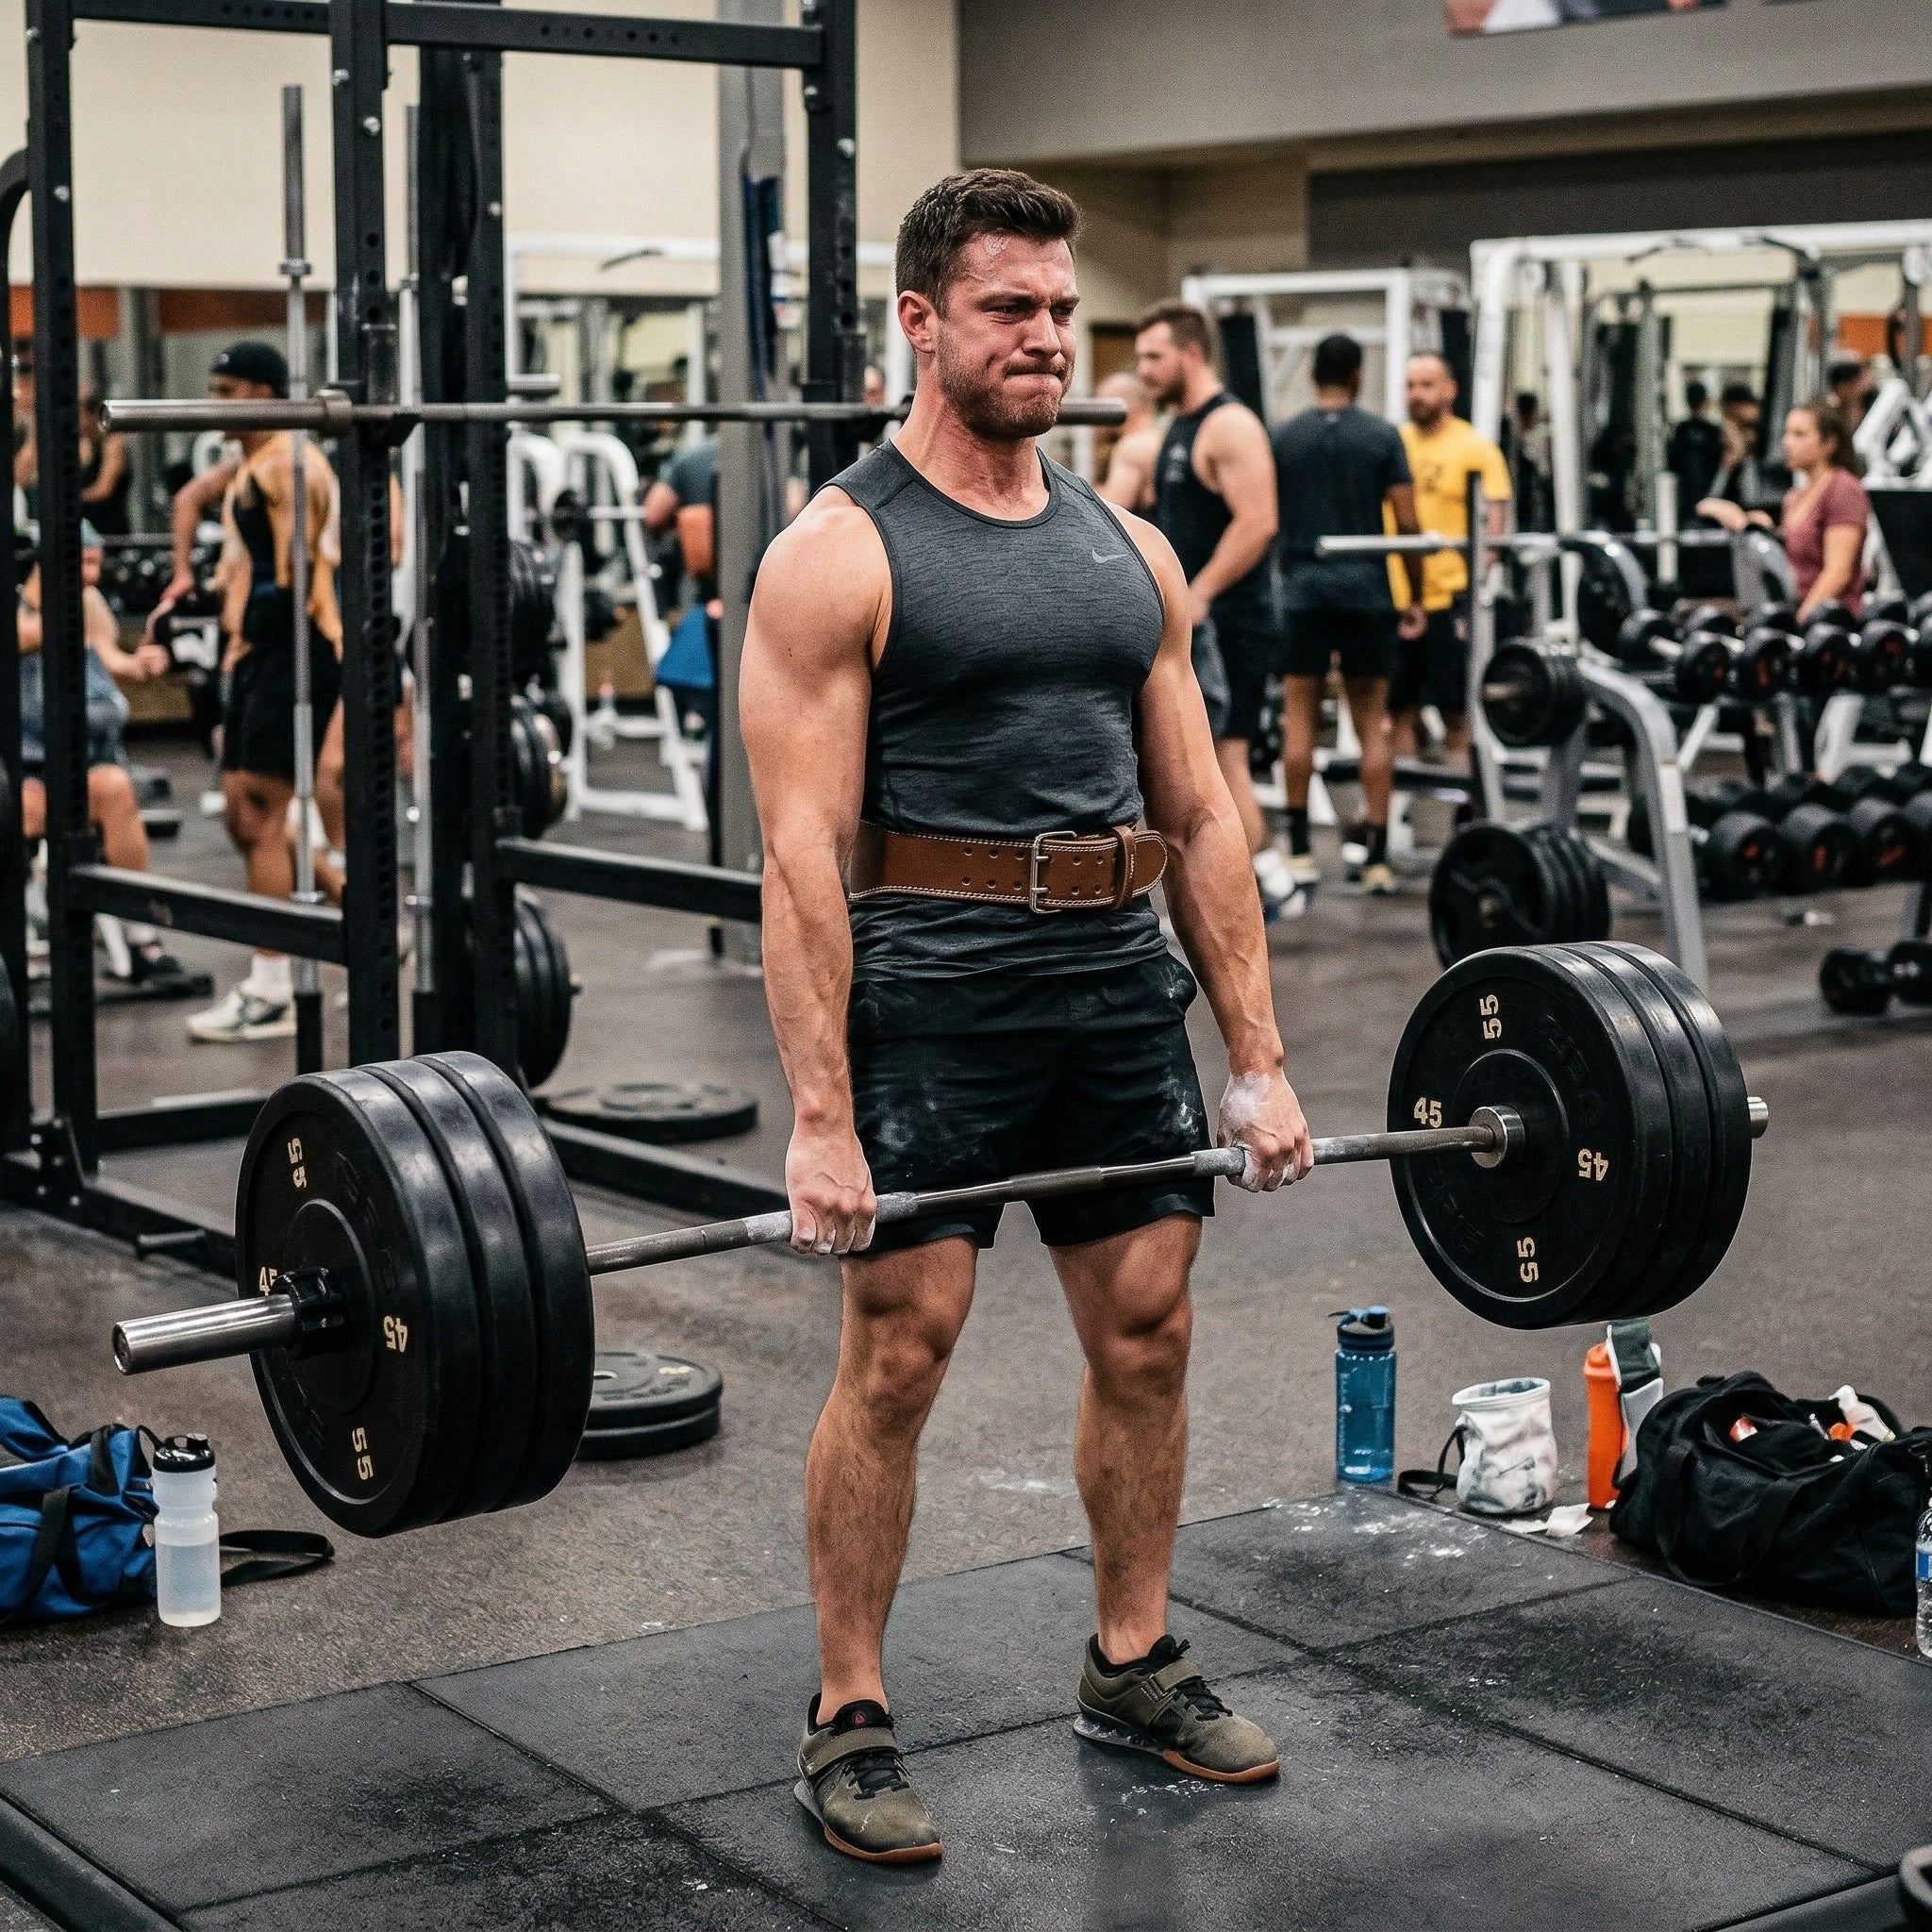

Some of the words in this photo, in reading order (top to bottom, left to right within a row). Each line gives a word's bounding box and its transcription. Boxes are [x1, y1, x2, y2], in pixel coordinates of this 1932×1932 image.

[1480, 994, 1503, 1040] 55
[1413, 1096, 1442, 1128] 45
[287, 1137, 308, 1189] 55
[1577, 1148, 1609, 1182] 45
[1516, 1237, 1540, 1283] 55
[383, 1315, 408, 1353] 45
[351, 1426, 374, 1480] 55
